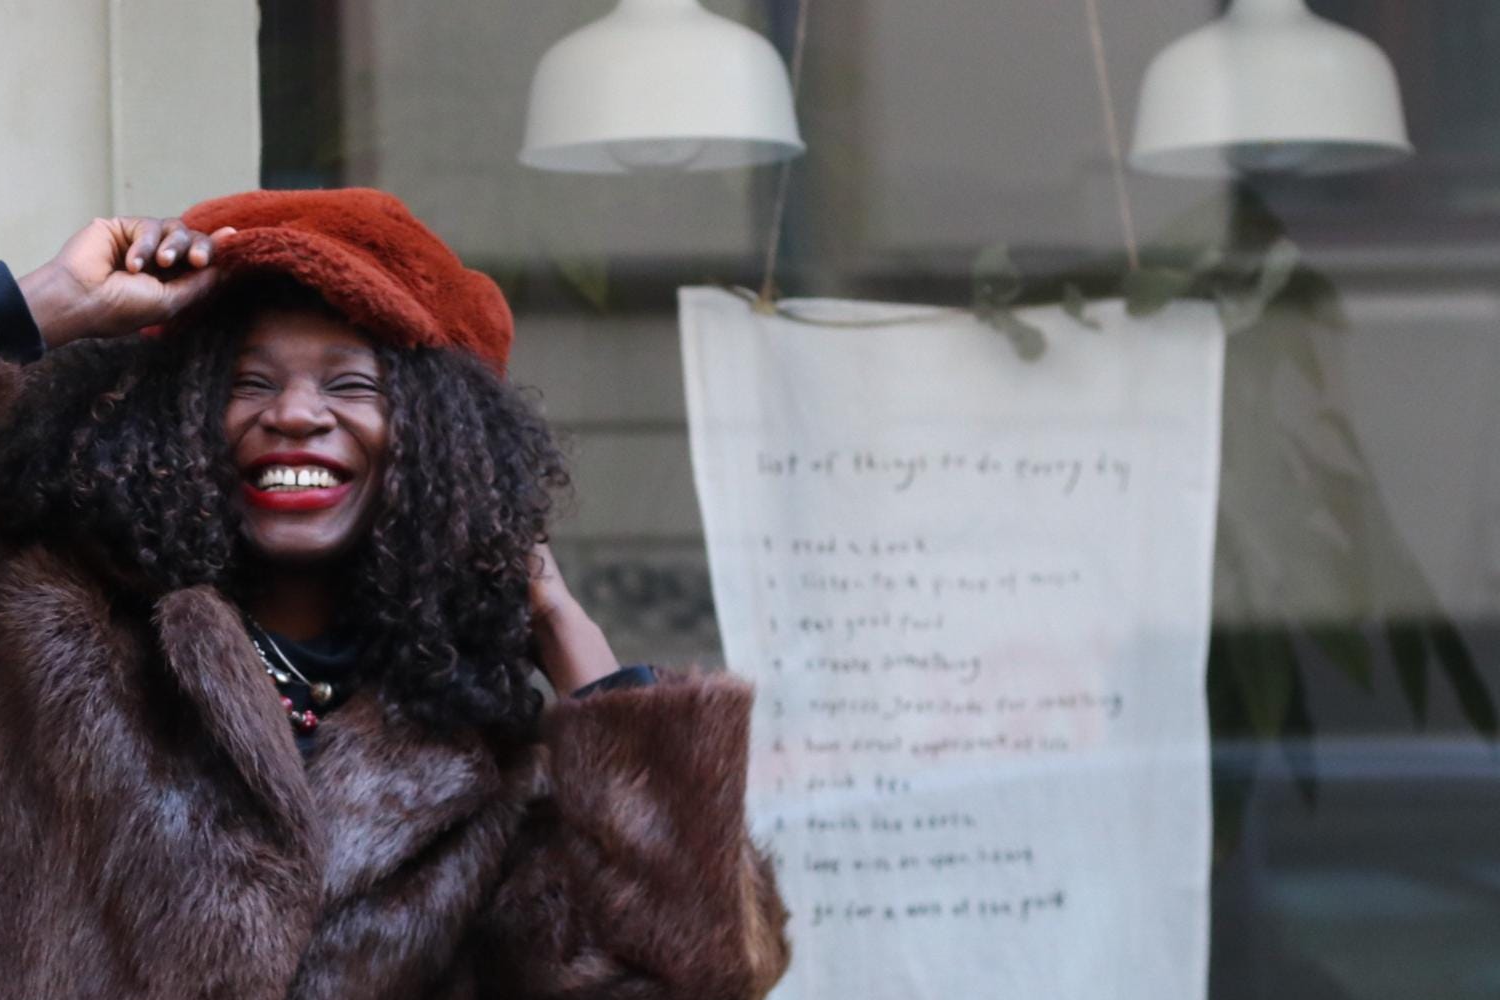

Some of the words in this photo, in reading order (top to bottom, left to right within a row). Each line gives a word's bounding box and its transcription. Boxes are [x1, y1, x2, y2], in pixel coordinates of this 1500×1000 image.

[810, 450, 839, 477] of
[853, 450, 928, 493] things
[1014, 457, 1083, 499] every
